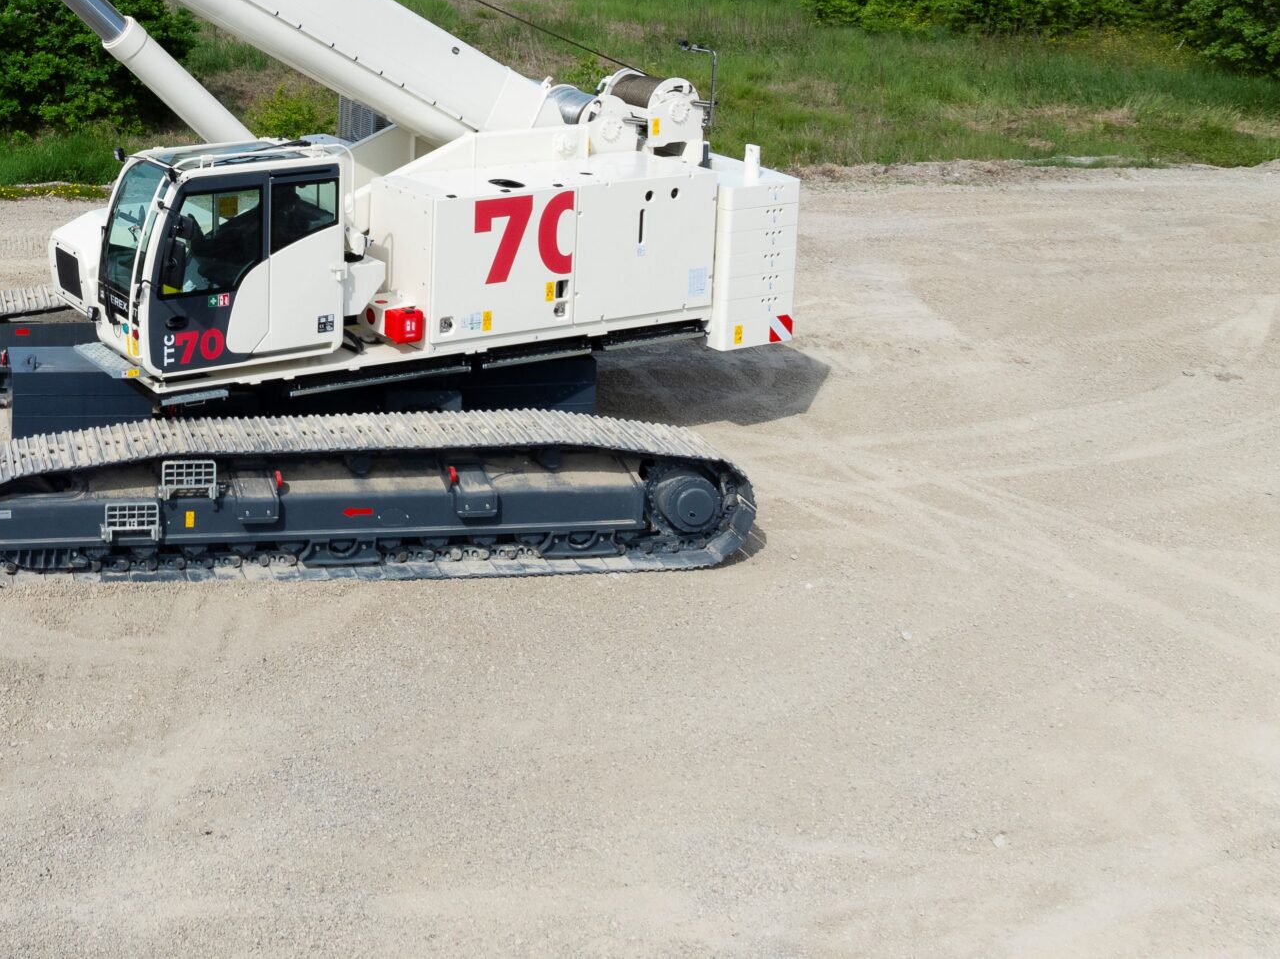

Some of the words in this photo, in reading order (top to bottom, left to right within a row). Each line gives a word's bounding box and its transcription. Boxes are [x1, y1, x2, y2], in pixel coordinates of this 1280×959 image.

[110, 294, 129, 313] EREX
[163, 334, 175, 367] TTC
[175, 328, 225, 365] 70
